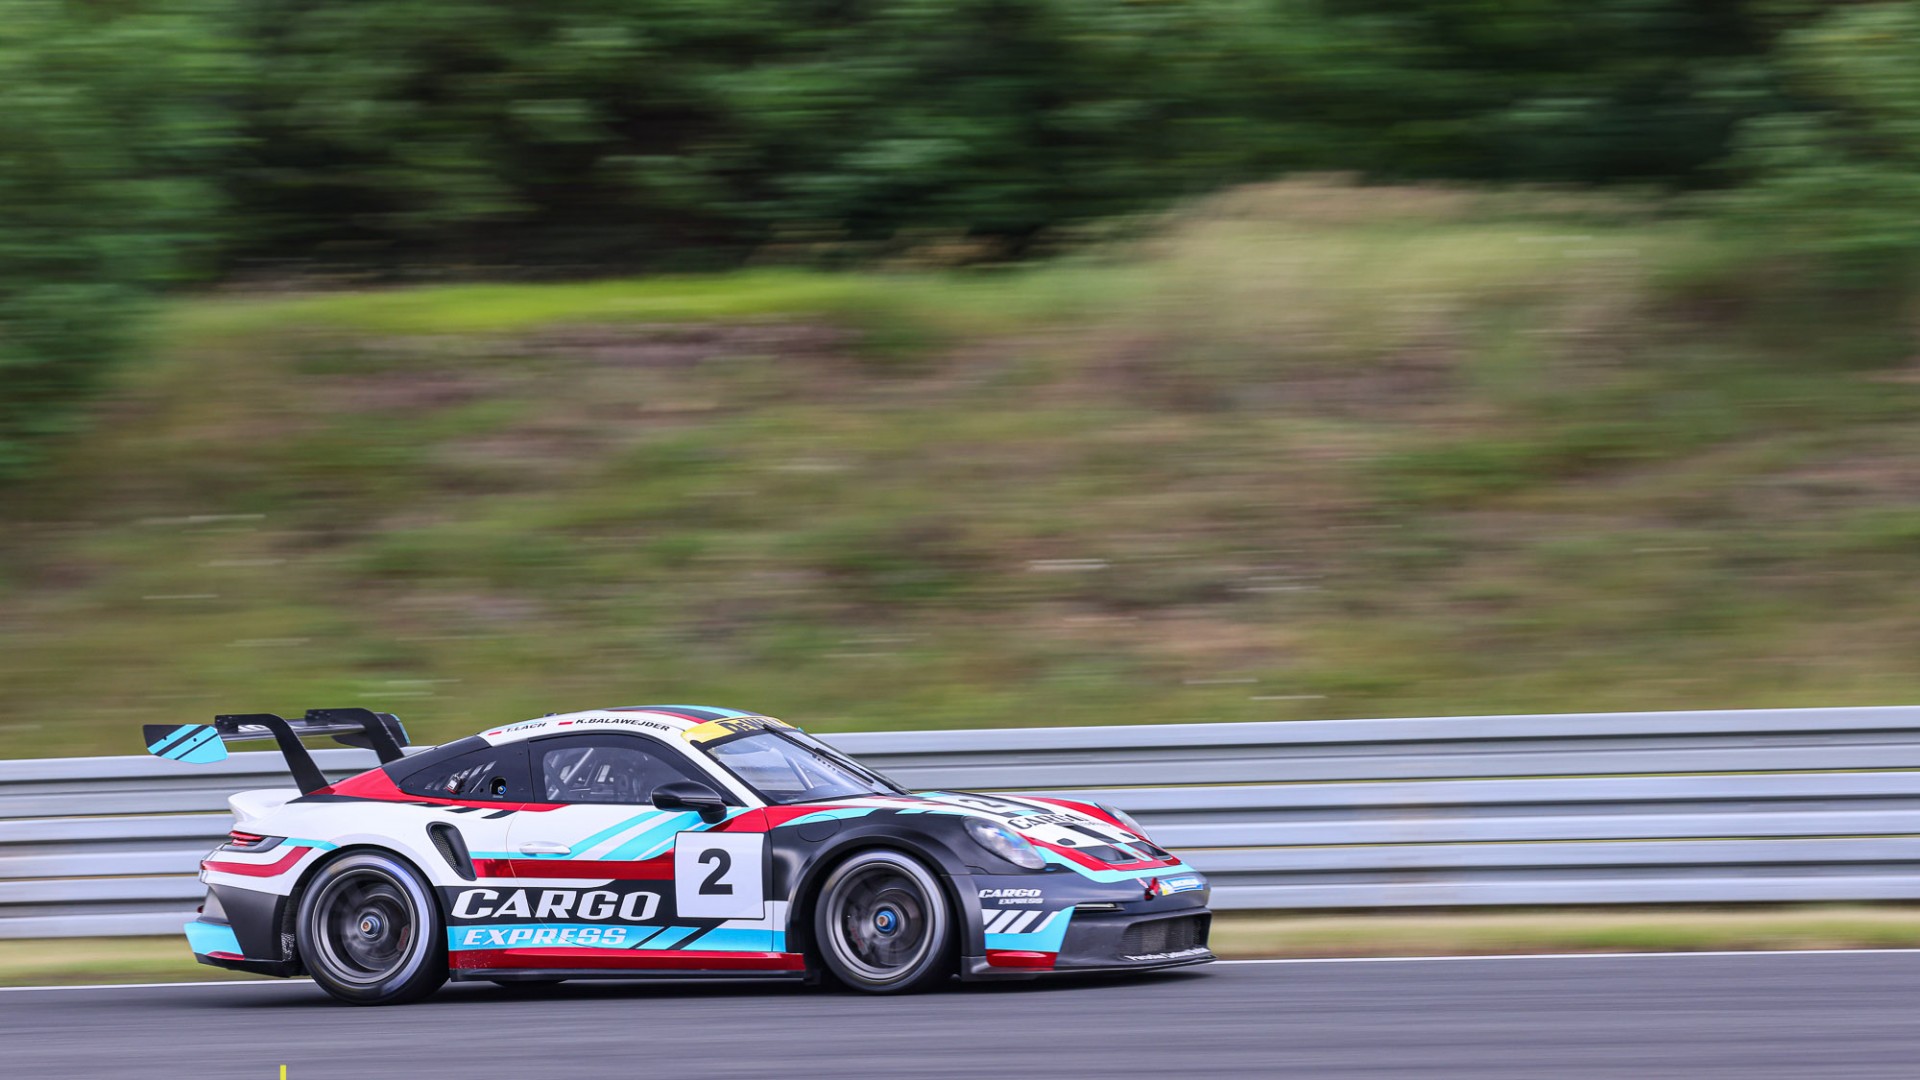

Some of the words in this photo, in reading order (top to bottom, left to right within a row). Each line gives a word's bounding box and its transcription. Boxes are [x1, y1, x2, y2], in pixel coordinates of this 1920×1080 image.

[575, 718, 671, 732] K.BALAWEJDER
[697, 848, 733, 896] 2
[978, 888, 1042, 899] CARGO
[451, 888, 662, 921] CARGO
[462, 927, 628, 946] EXPRESS
